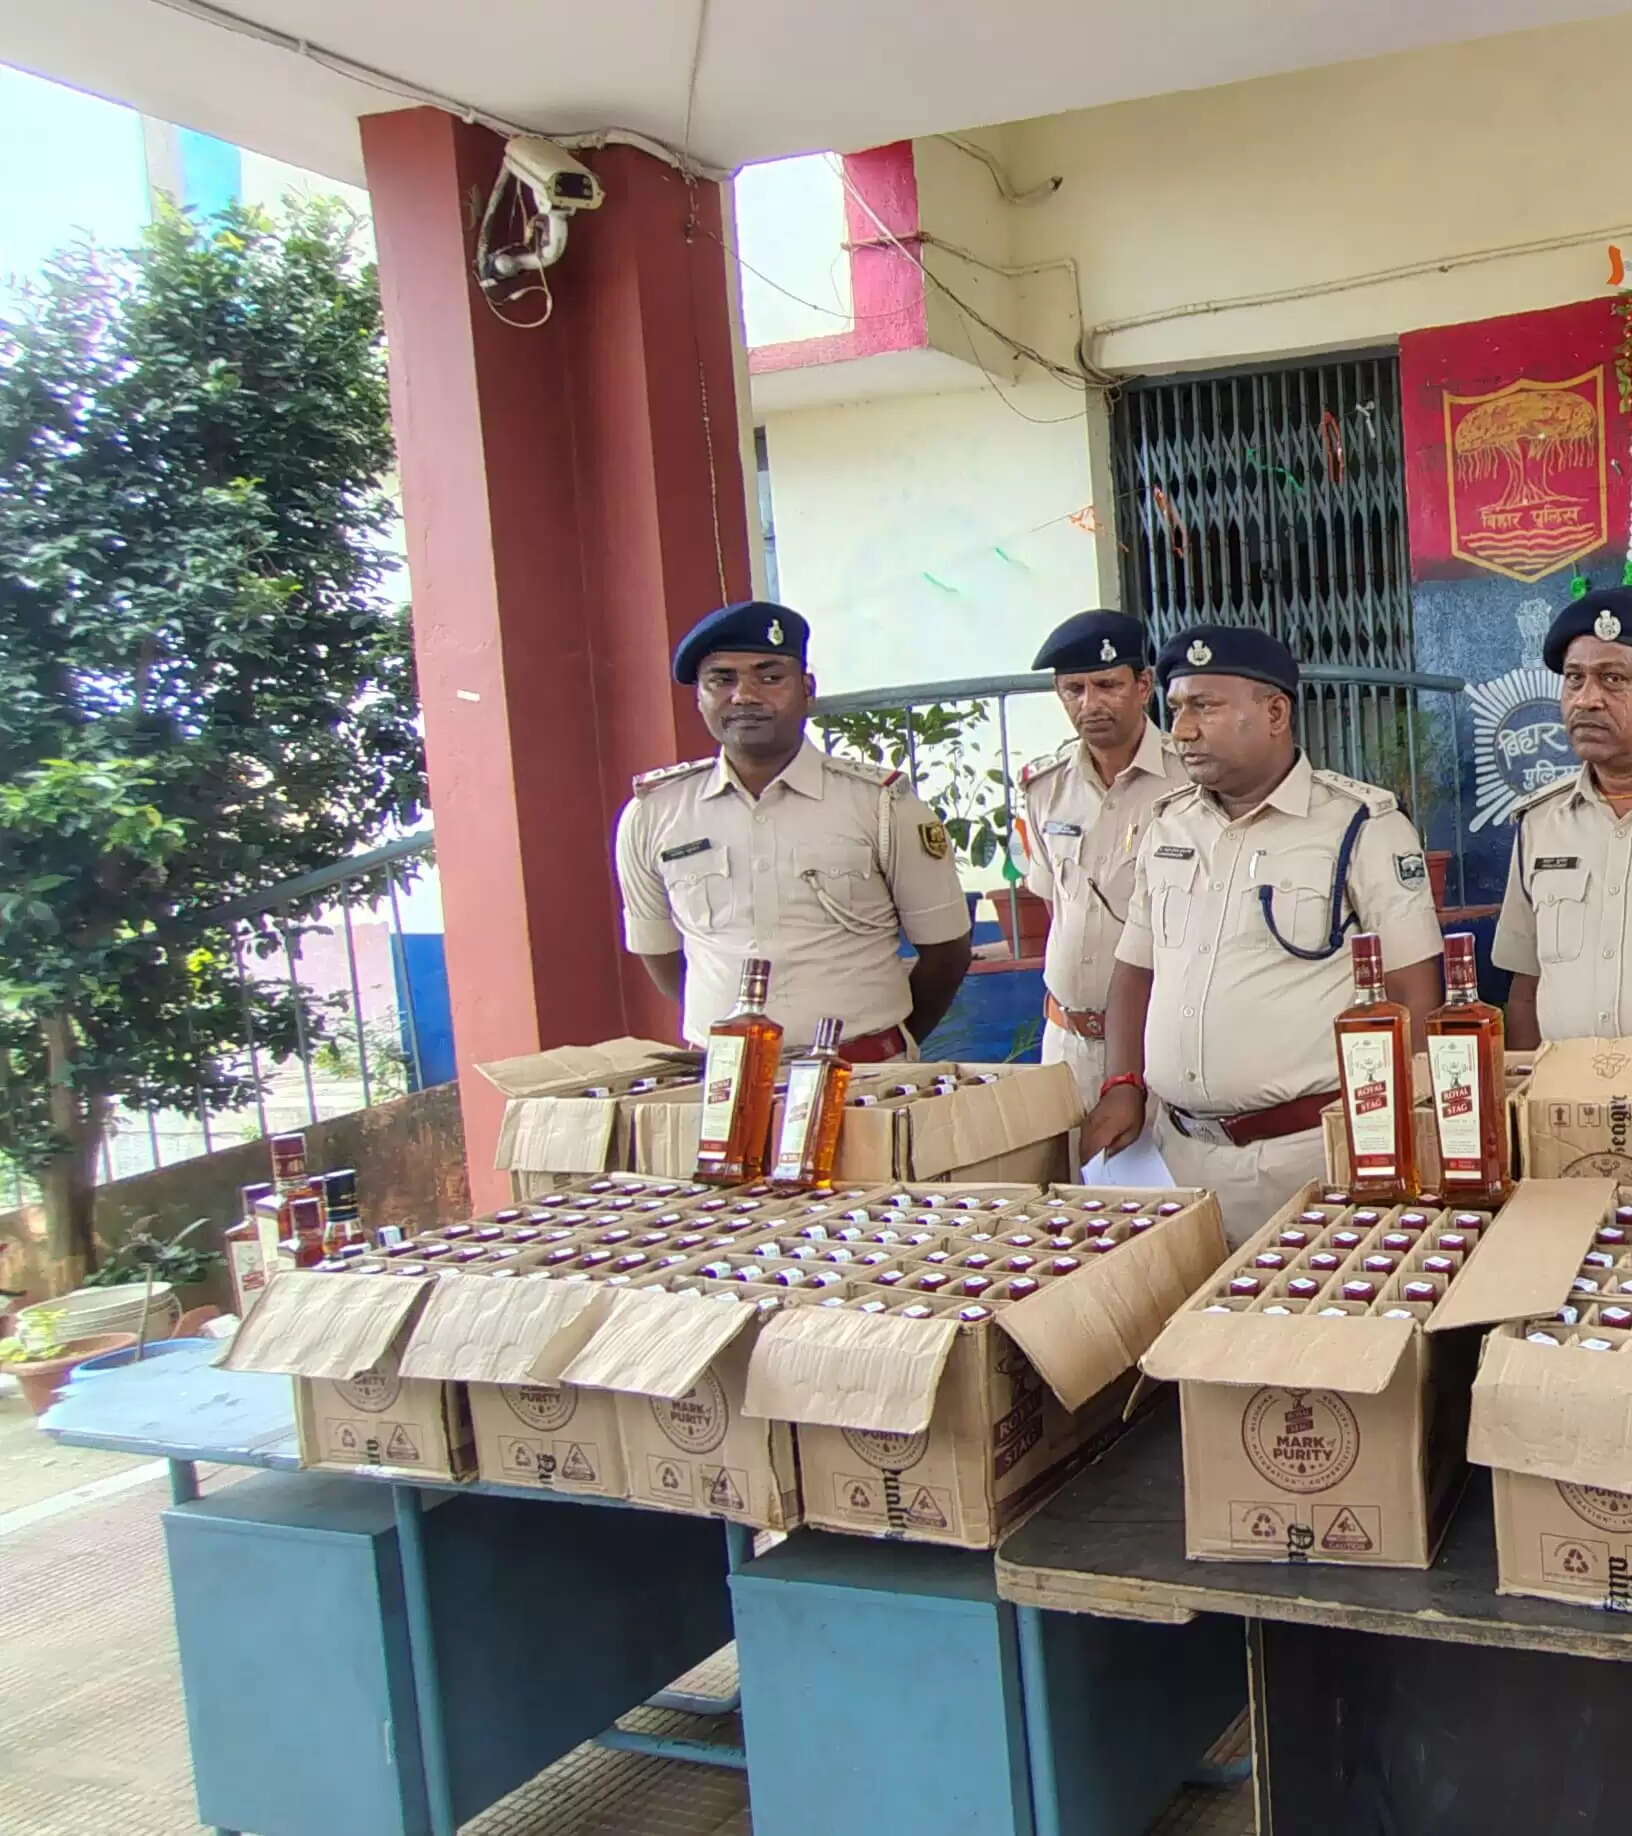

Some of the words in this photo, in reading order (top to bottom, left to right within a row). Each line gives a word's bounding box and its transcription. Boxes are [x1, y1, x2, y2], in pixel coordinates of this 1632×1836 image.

[1481, 508, 1523, 530] बिहार
[1530, 505, 1582, 529] पुलिस
[1498, 722, 1568, 770] बिहार
[1356, 1082, 1384, 1098] ROYAL
[1443, 1089, 1469, 1101] ROYAL
[1360, 1098, 1383, 1112] STAG
[1447, 1103, 1468, 1115] STAG
[671, 1399, 705, 1413] MARK
[670, 1410, 711, 1428] PURITY
[1276, 1436, 1325, 1448] MARK
[1272, 1448, 1333, 1461] PURITY
